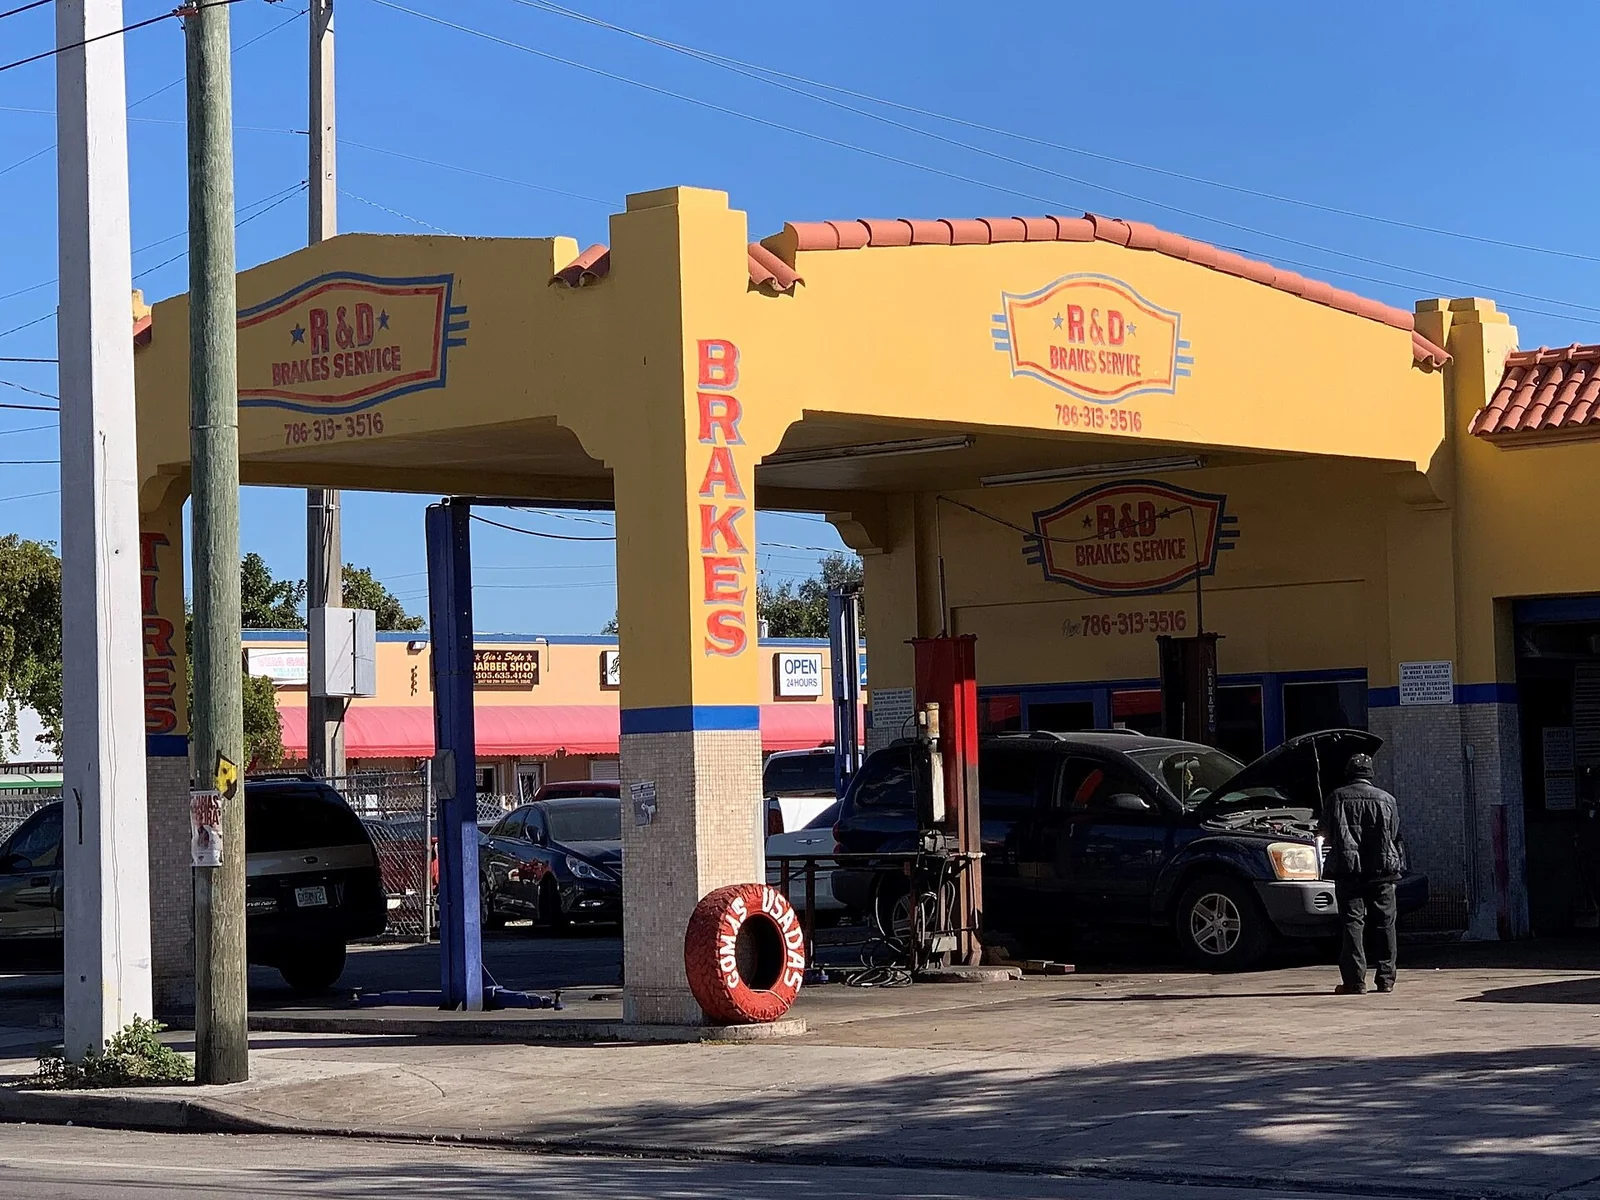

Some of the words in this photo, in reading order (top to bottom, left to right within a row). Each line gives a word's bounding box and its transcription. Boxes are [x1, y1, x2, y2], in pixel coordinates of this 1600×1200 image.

[272, 356, 330, 386] BRAKES
[333, 346, 401, 378] SERVICE
[1050, 345, 1097, 374] BRAKES
[1099, 350, 1142, 377] SERVICE
[1055, 404, 1142, 432] 786-313-3516
[696, 339, 748, 657] BRAKES
[1075, 543, 1130, 567] BRAKES
[1132, 538, 1186, 567] SERVICE
[140, 532, 177, 735] TIRES
[1082, 610, 1187, 636] 786-313-3516
[482, 652, 502, 663] Gio's
[504, 652, 525, 662] Style
[510, 662, 537, 671] SHOP
[785, 659, 817, 674] OPEN
[720, 897, 748, 989] GOMAS
[762, 886, 805, 993] USADAS
